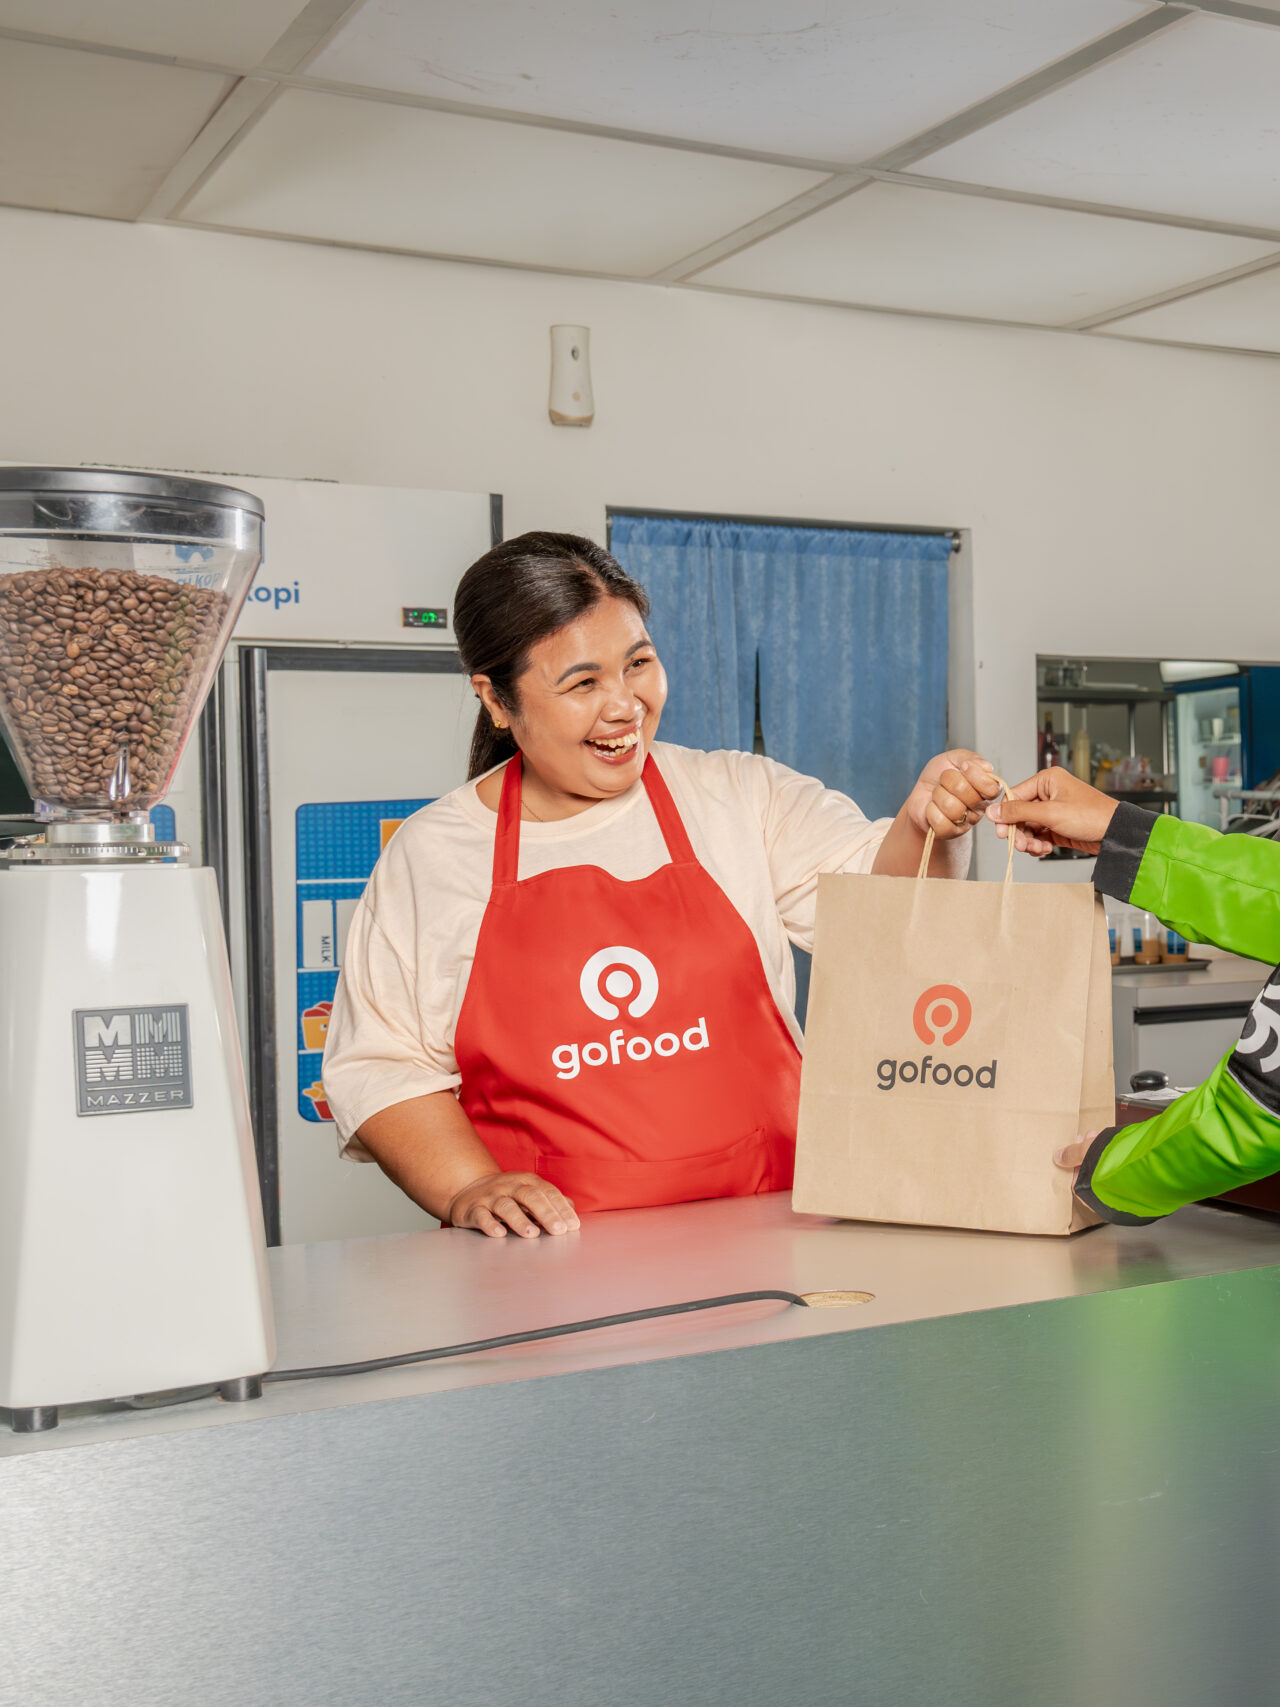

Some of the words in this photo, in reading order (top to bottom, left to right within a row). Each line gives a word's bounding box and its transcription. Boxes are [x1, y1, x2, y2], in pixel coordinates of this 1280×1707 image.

[248, 581, 299, 609] opi
[321, 936, 331, 963] MILK
[552, 1017, 709, 1080] gofood
[877, 1055, 997, 1091] gofood
[87, 1090, 184, 1107] MAZZER
